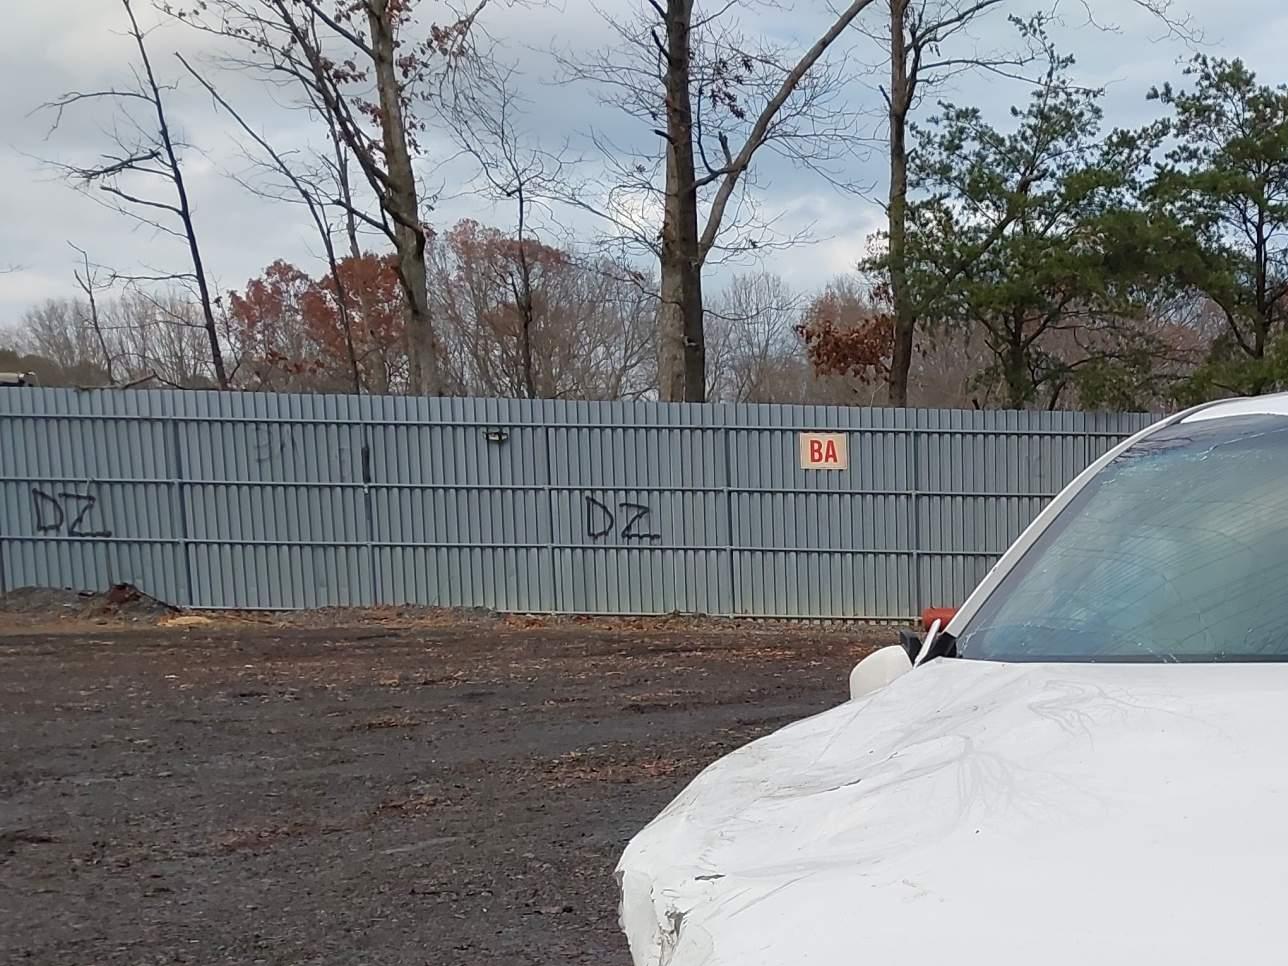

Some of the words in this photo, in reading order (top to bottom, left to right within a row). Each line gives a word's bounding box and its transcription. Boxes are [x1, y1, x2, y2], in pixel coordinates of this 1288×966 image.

[809, 439, 838, 463] BA
[32, 487, 112, 537] DZ
[585, 495, 661, 540] DZ
